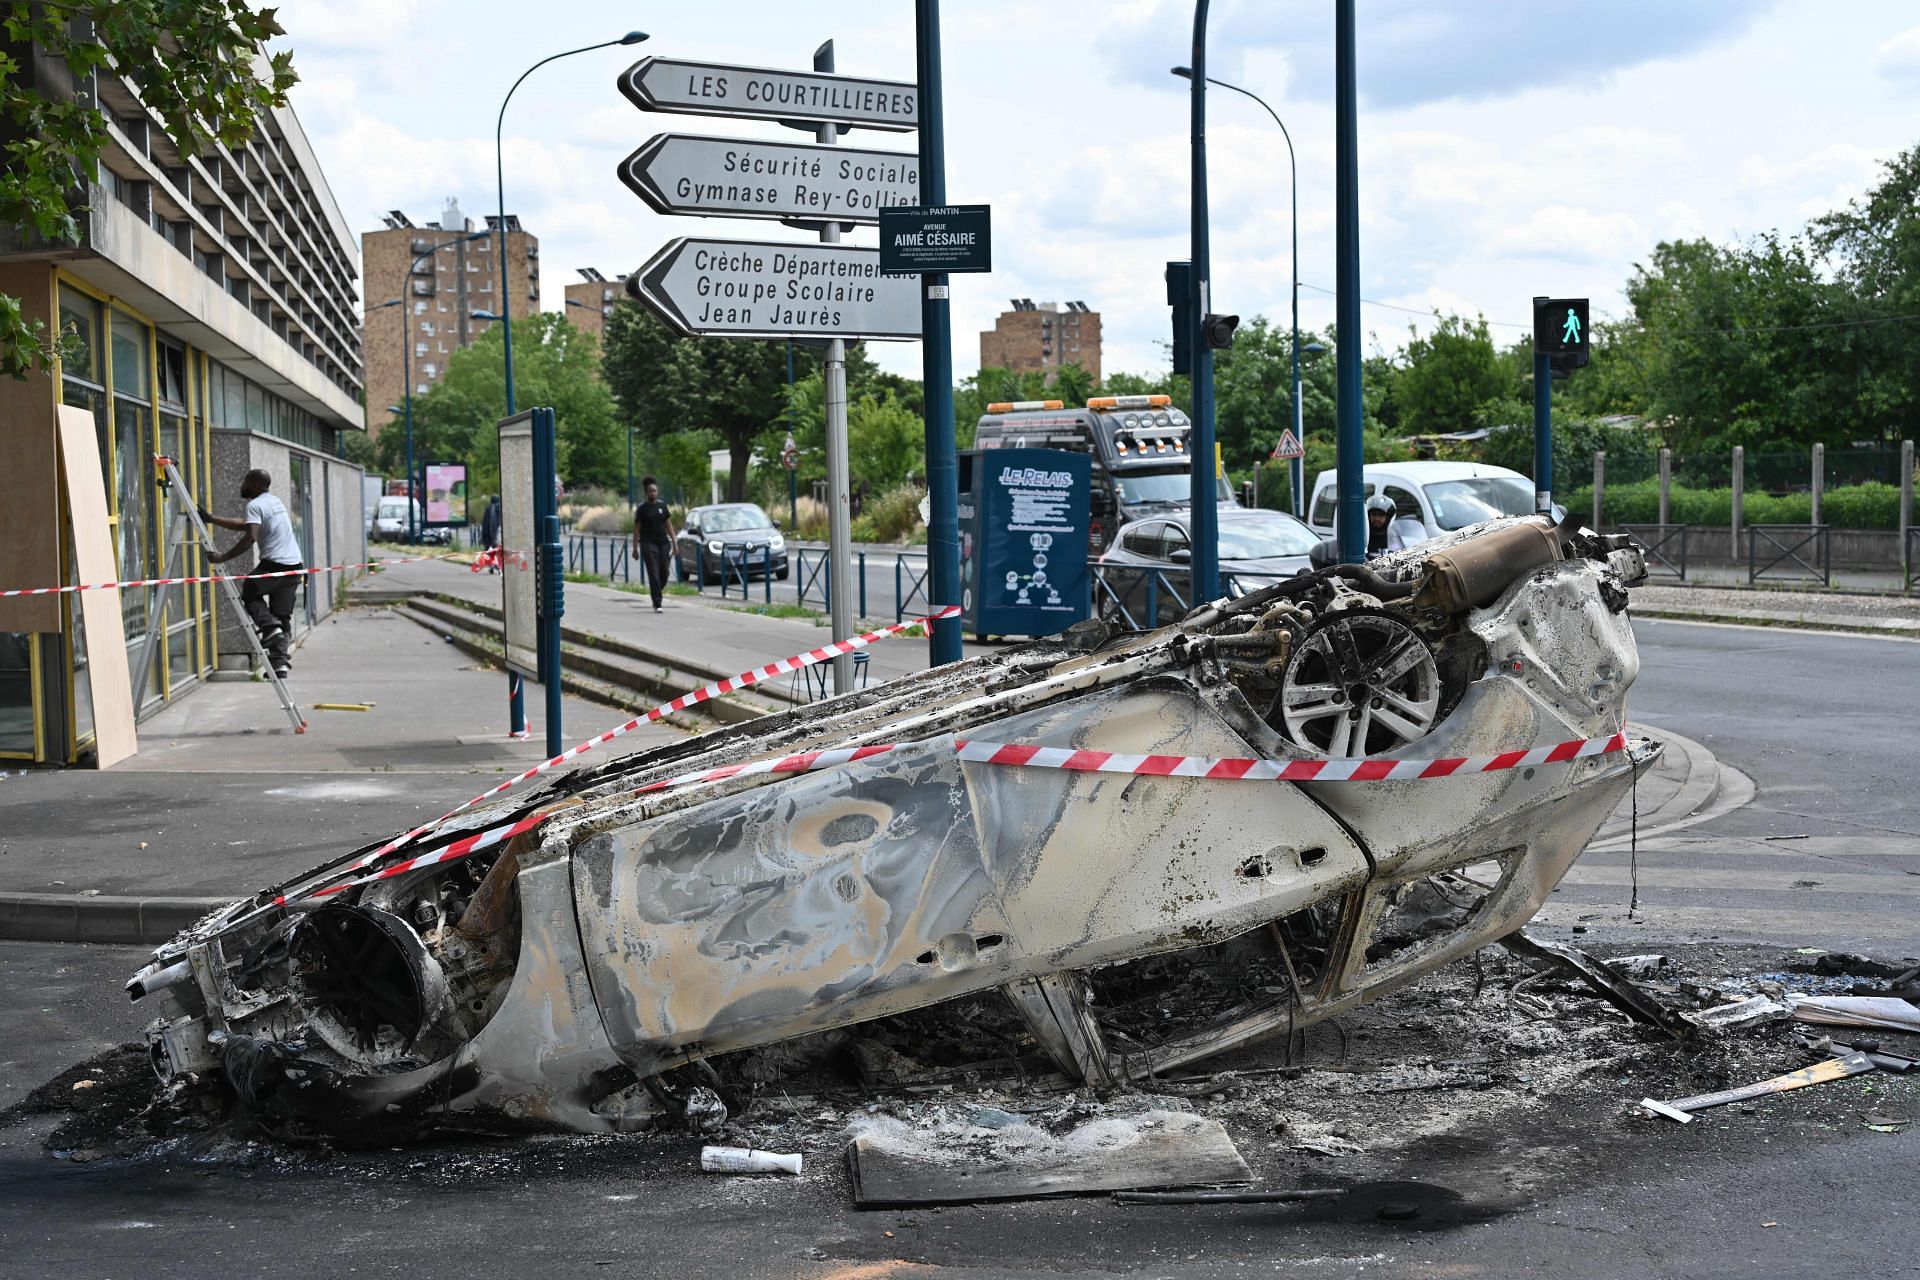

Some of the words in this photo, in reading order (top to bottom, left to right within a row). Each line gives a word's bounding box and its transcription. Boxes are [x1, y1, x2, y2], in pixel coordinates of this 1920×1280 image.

[688, 75, 729, 99] LES
[746, 80, 915, 115] COURTILLIERES
[724, 151, 822, 178] Sécurité
[838, 160, 918, 184] Sociale
[676, 177, 778, 205] Gymnase
[929, 208, 960, 216] PANTIN
[894, 230, 924, 247] AIMÉ
[926, 230, 976, 246] CÉSAIRE
[695, 250, 764, 274] Crèche
[697, 276, 778, 303] Groupe
[786, 281, 875, 304] Scolaire
[699, 303, 753, 325] Jean
[769, 304, 842, 327] Jaurès
[1023, 468, 1072, 487] RELAIS
